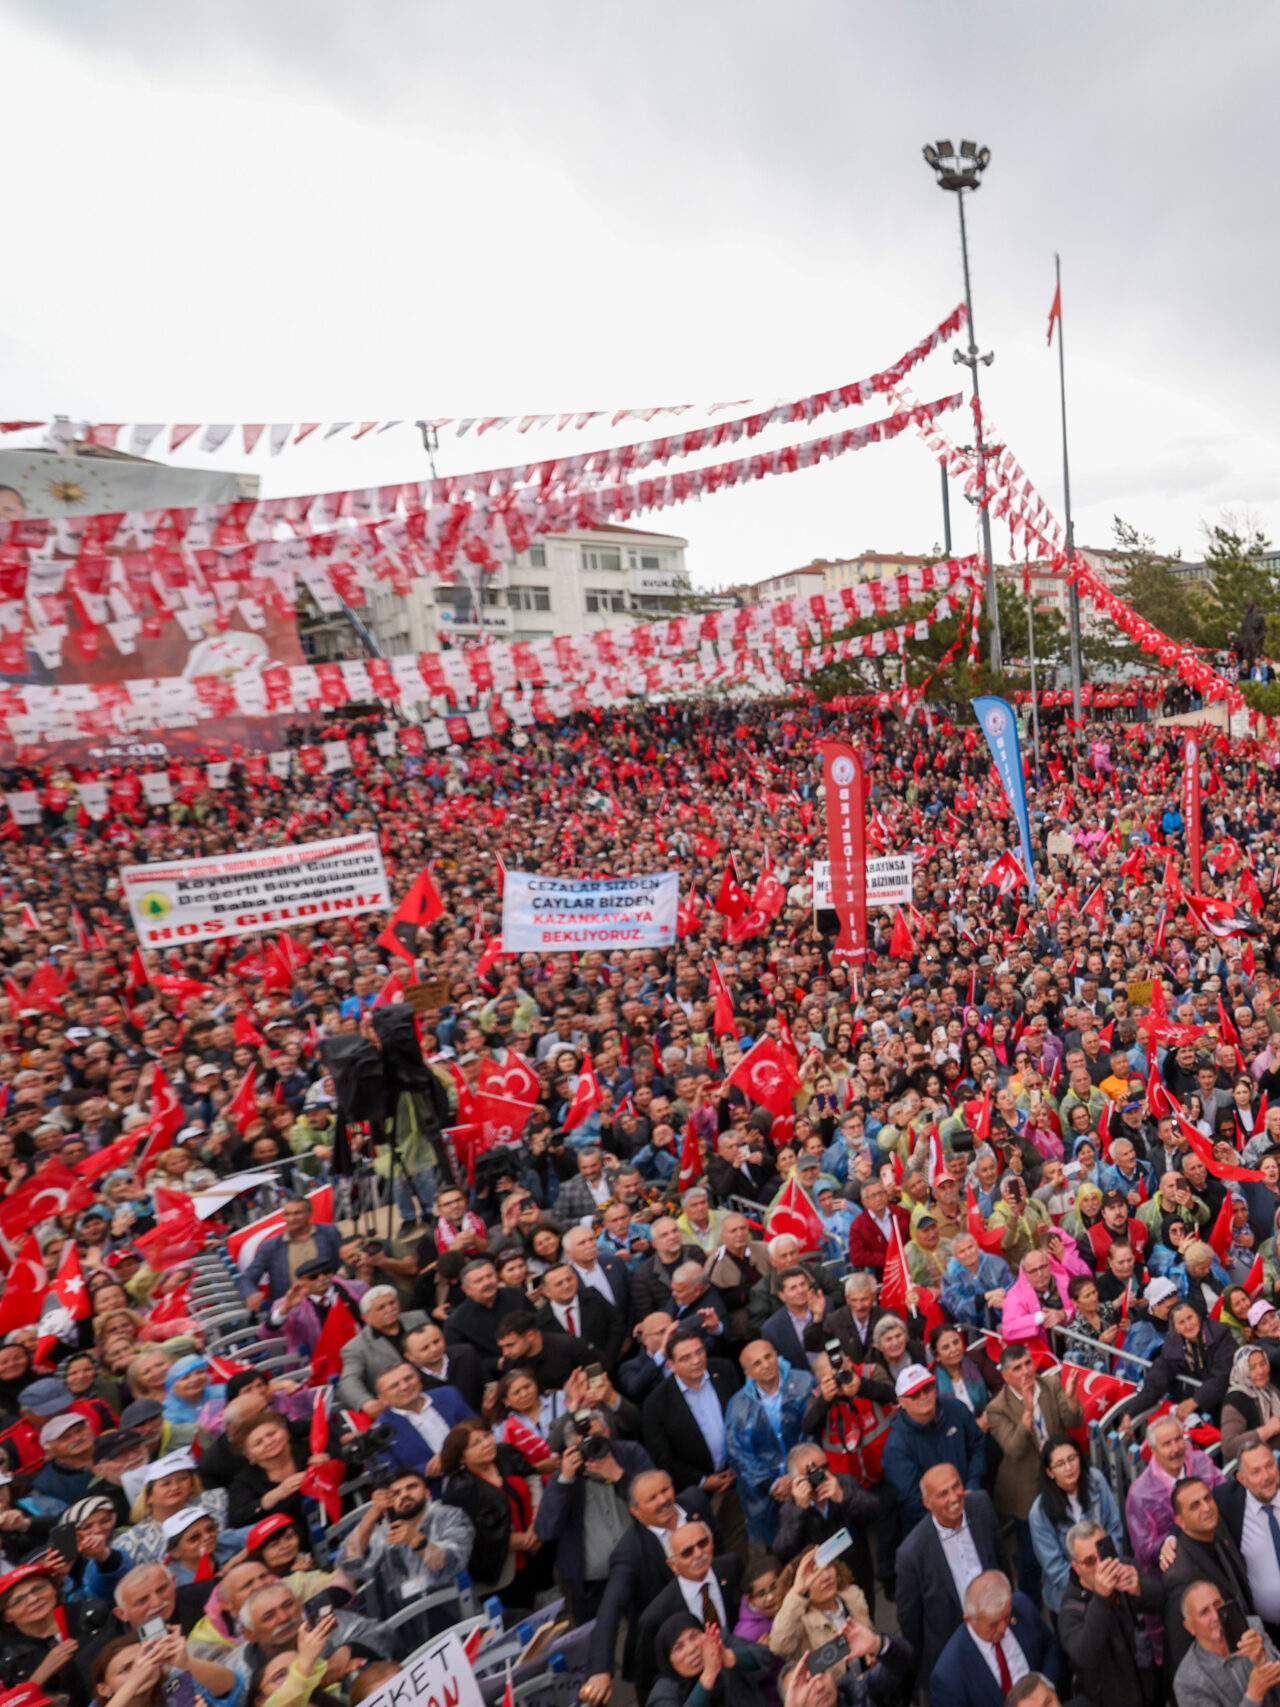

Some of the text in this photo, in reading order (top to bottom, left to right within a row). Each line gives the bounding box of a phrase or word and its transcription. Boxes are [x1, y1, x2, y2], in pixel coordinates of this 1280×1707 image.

[532, 896, 655, 910] ÇAYLAR BİZDEN
[149, 892, 383, 943] HOŞ GELDİNİZ
[533, 911, 653, 925] KAZANKAYA'YA
[541, 928, 646, 943] BEKLİYORUZ.
